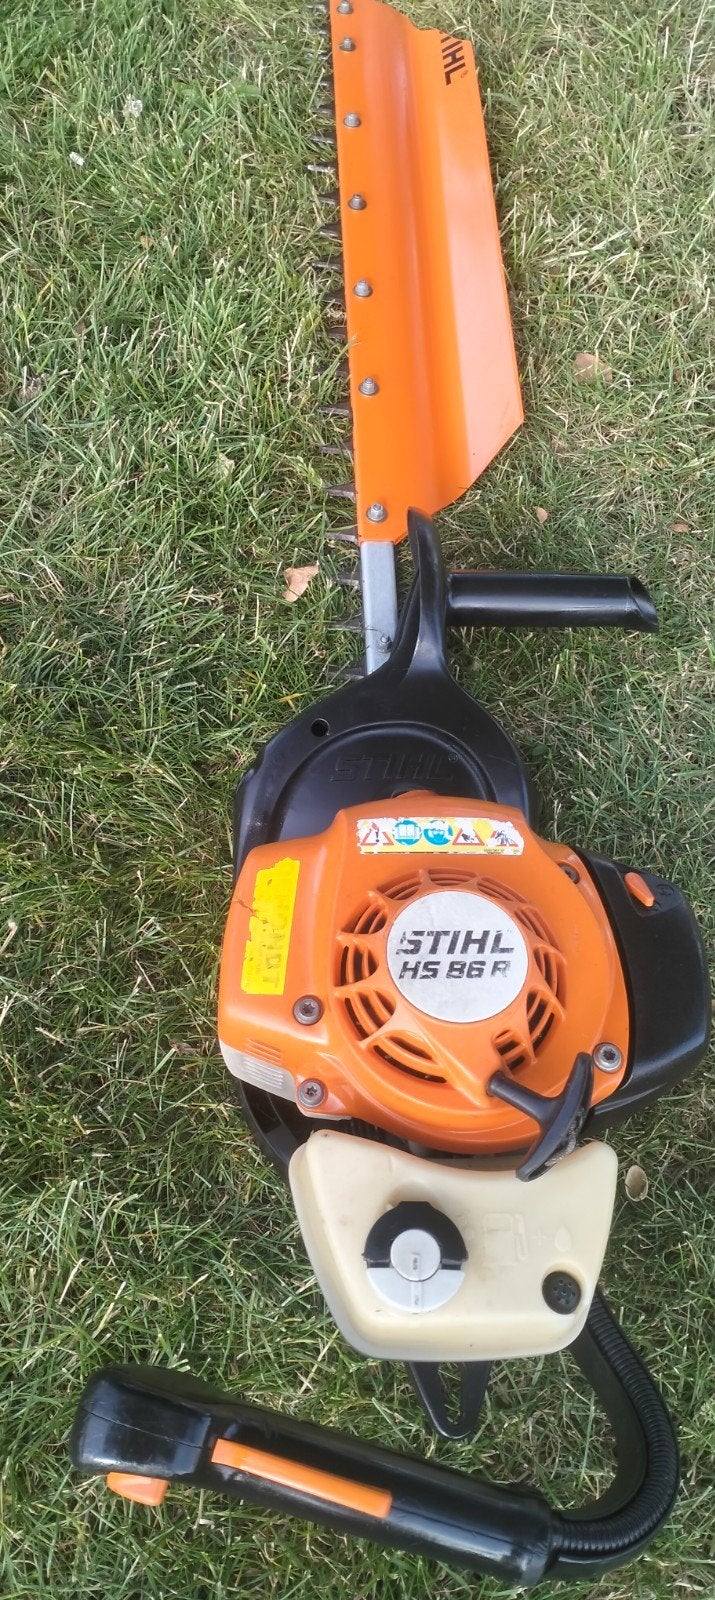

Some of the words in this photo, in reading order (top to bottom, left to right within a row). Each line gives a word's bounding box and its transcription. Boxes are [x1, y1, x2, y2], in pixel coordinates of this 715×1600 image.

[329, 753, 454, 782] STIHL
[396, 930, 515, 955] STIHL
[399, 960, 441, 979] HS
[446, 960, 487, 979] 86
[491, 960, 511, 978] R
